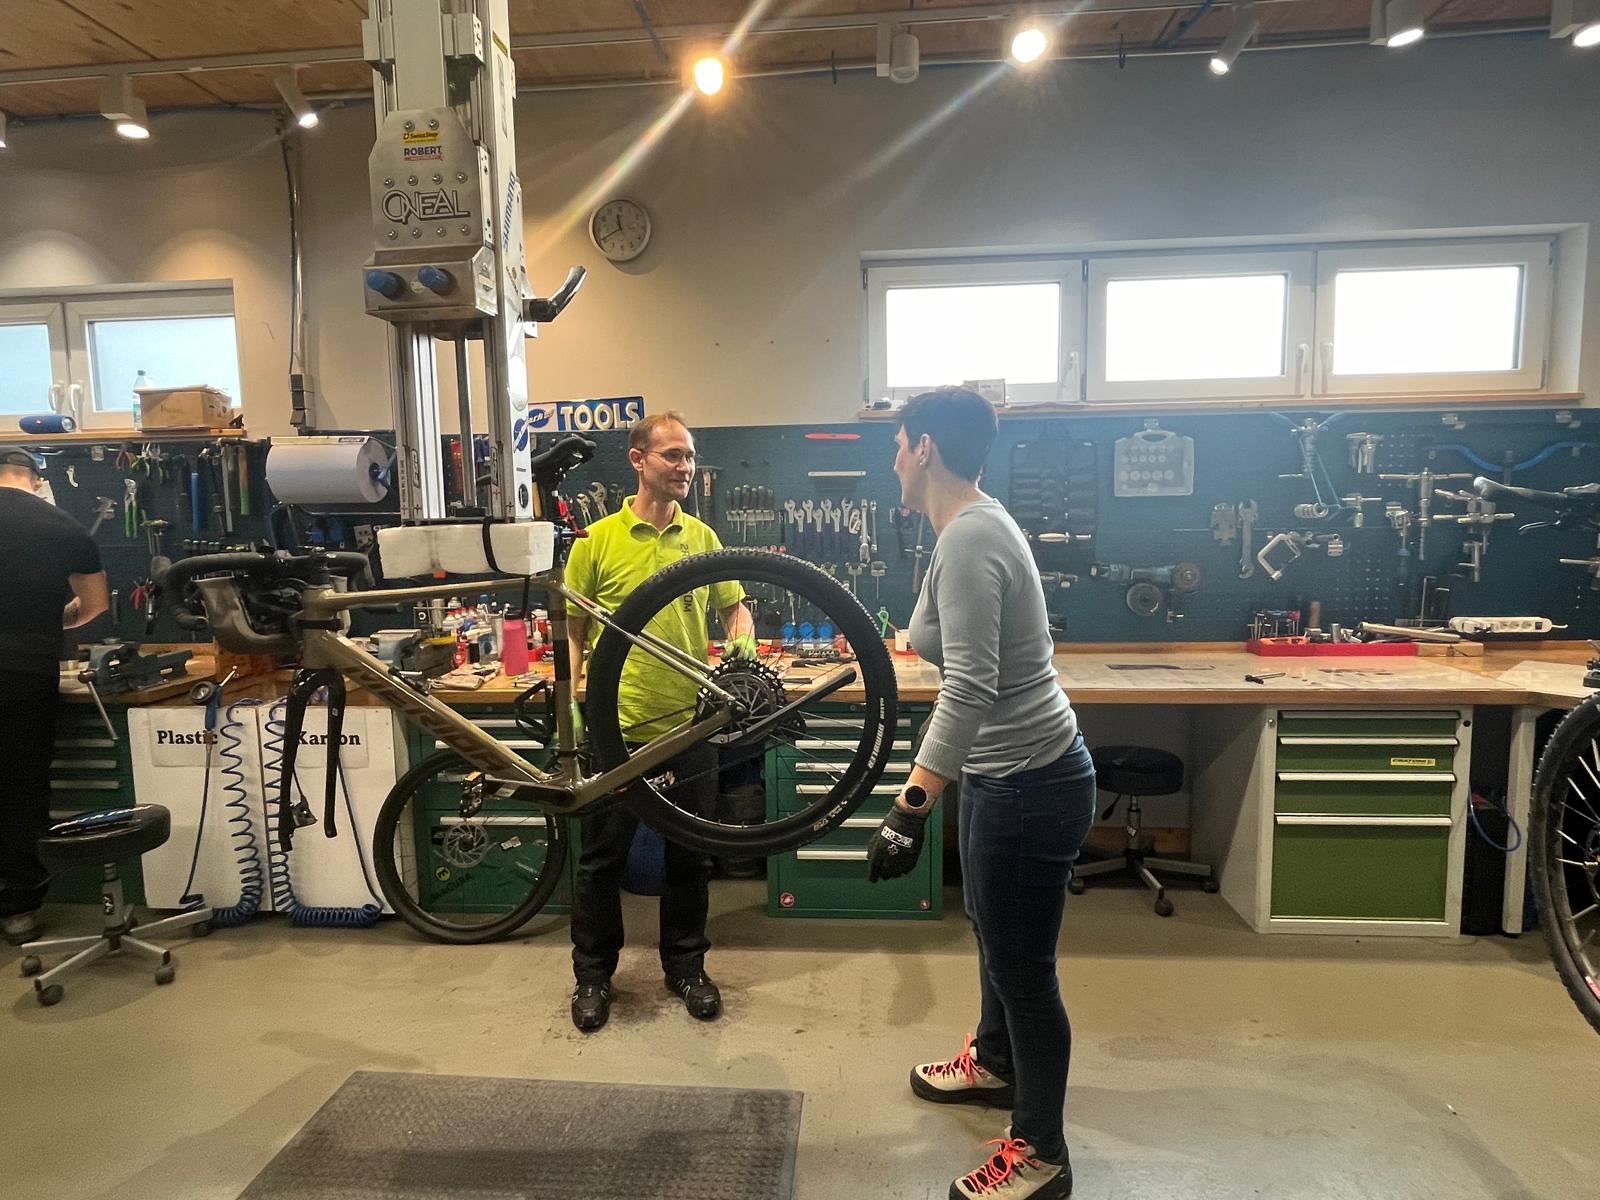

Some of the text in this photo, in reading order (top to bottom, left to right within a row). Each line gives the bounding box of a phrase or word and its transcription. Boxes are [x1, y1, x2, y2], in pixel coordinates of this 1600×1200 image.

[403, 145, 442, 156] ROBERT
[502, 171, 517, 252] SHIMANO
[560, 401, 640, 431] TOOLS
[297, 731, 361, 746] Karon
